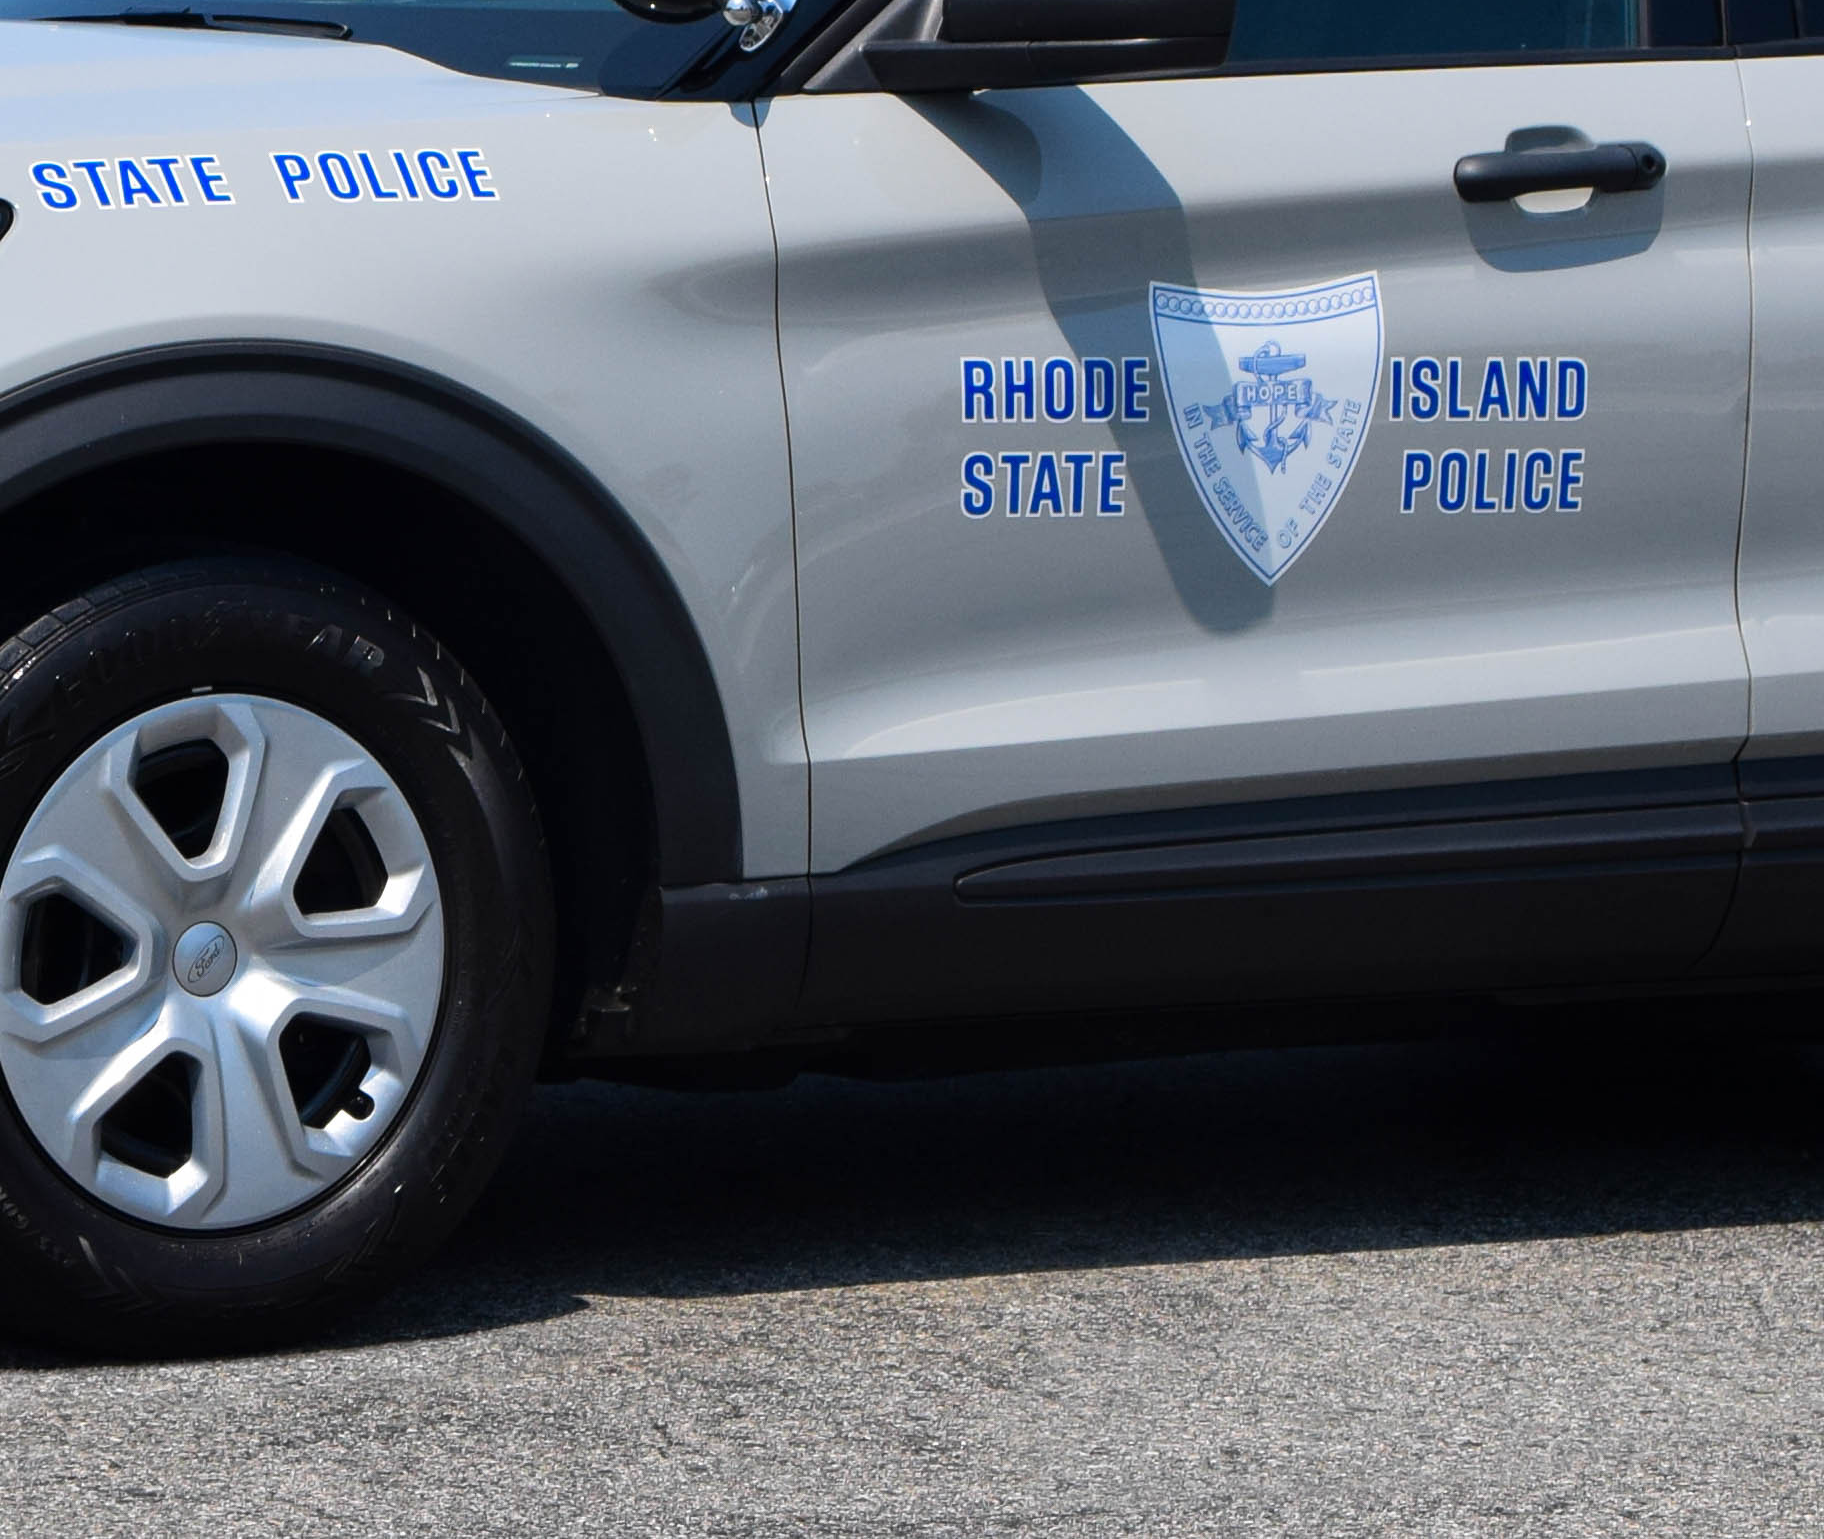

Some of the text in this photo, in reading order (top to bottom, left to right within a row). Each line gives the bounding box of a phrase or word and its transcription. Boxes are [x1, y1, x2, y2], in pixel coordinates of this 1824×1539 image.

[30, 148, 500, 212] STATE POLICE
[961, 356, 1588, 423] RHODE ISLAND
[1246, 384, 1298, 402] HOPE
[961, 448, 1586, 518] STATE POLICE
[1183, 398, 1362, 552] IN THE SERVICE OF THE STATE
